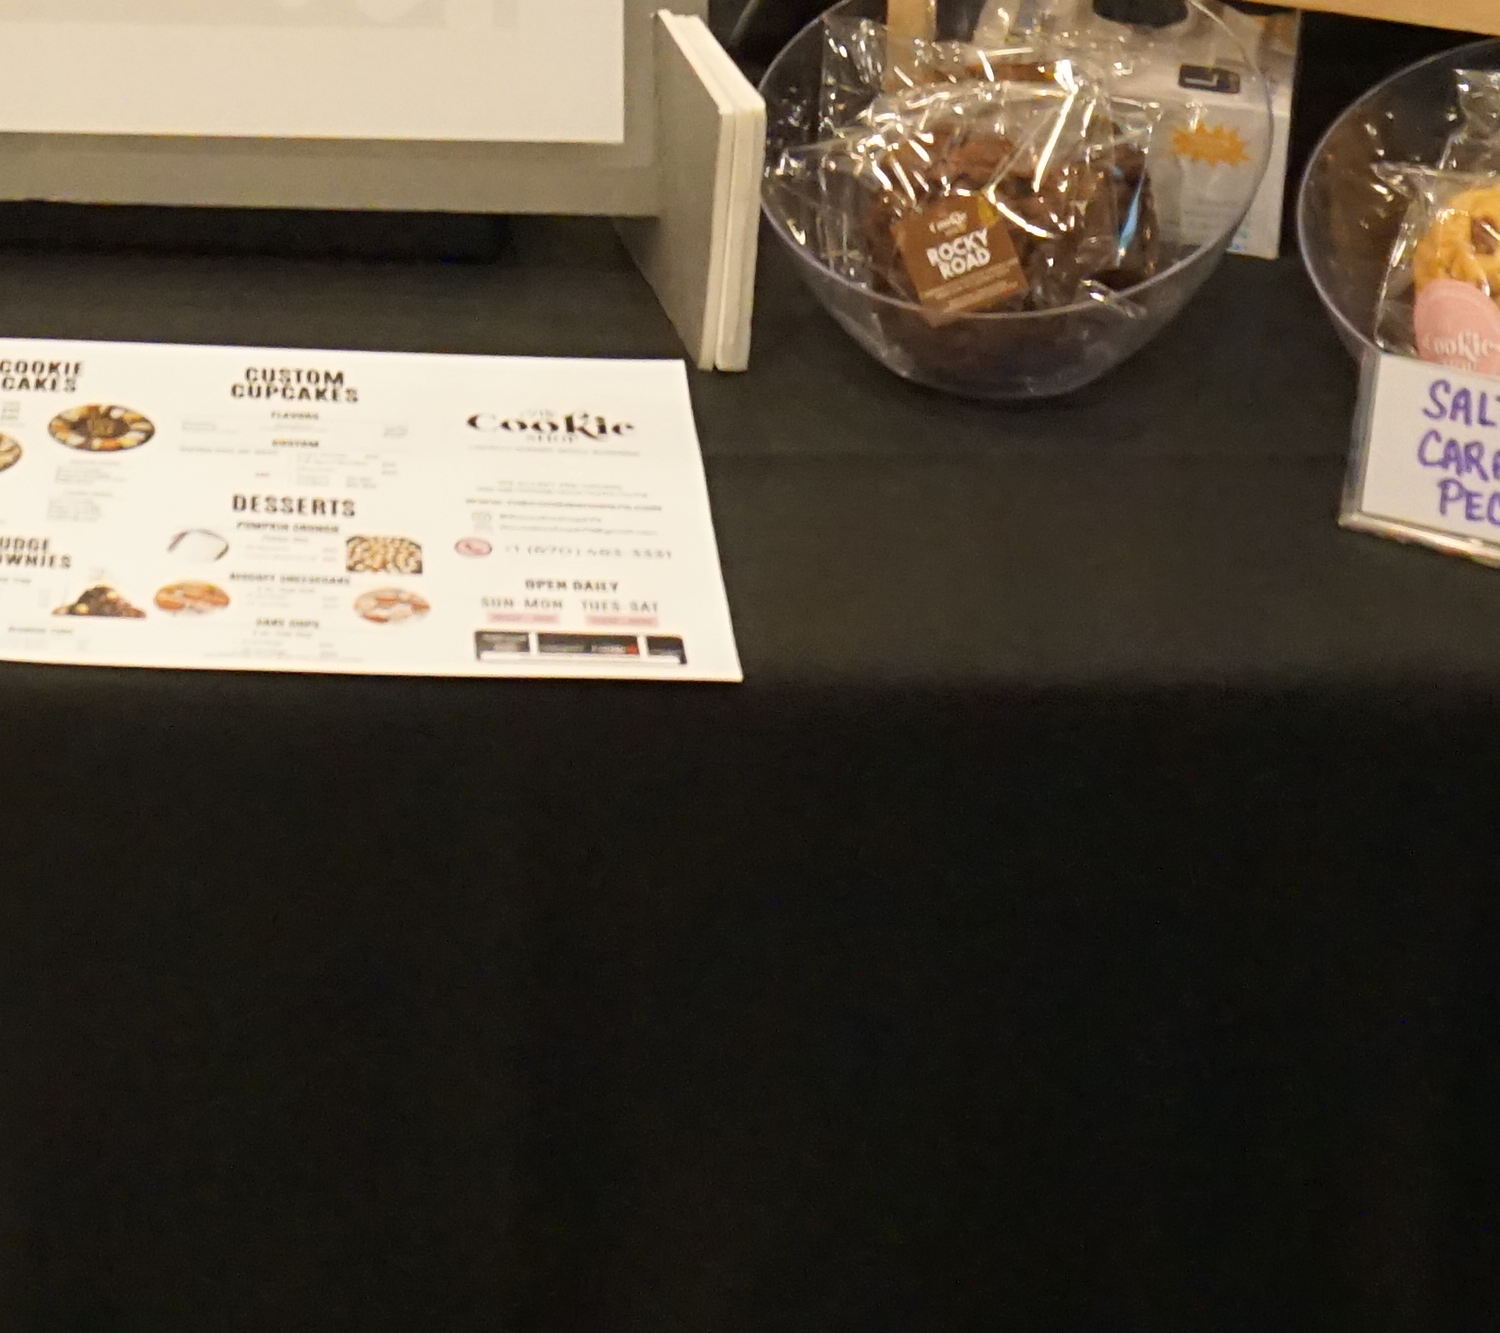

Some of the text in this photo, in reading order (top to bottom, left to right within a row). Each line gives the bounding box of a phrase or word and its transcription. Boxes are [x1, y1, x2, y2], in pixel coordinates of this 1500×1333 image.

[926, 226, 989, 267] ROCKY
[938, 247, 991, 281] ROAD
[1, 375, 78, 393] CAKES
[244, 367, 346, 387] CUSTOM
[230, 384, 361, 404] CUPCAKES
[465, 409, 637, 445] Cookie
[231, 495, 357, 517] DESSERTS
